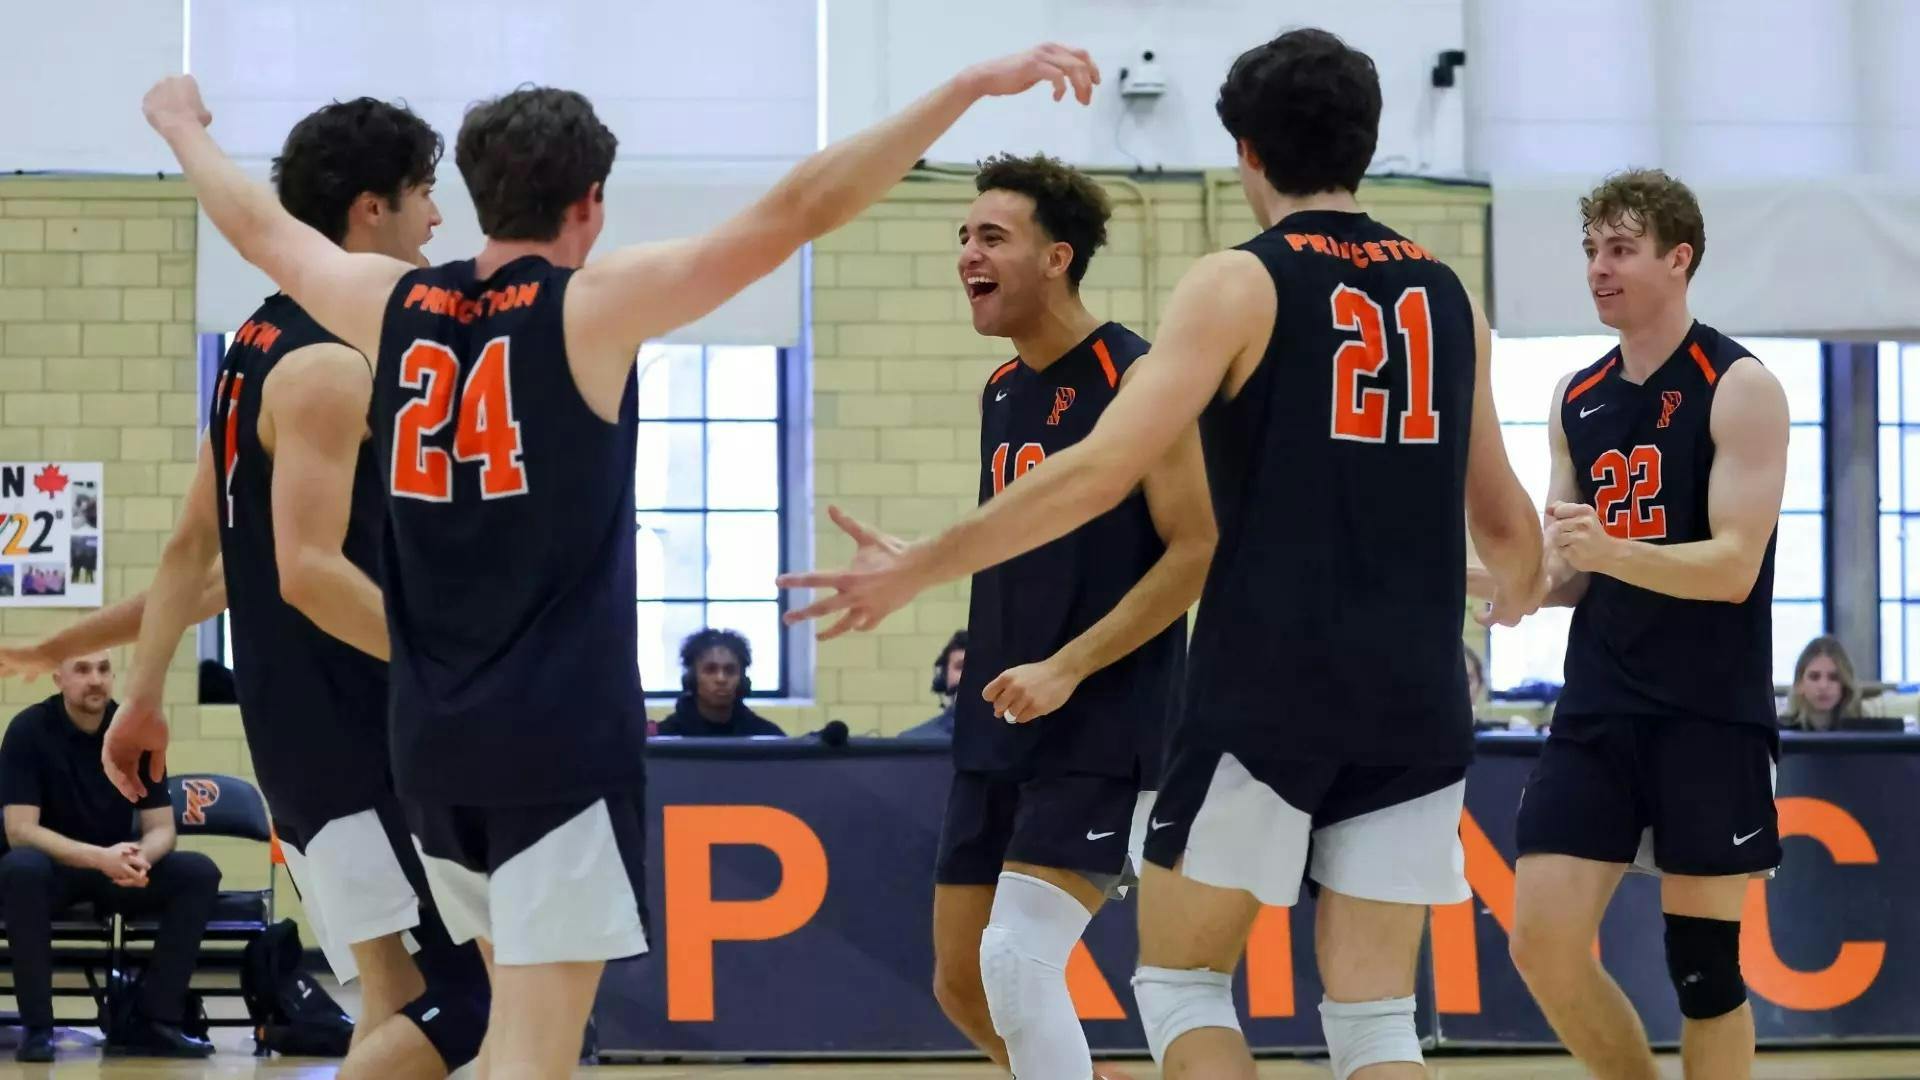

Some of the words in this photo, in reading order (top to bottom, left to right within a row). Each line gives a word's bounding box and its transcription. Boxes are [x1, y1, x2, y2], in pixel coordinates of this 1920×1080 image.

[391, 335, 529, 503] 24
[1330, 282, 1440, 444] 21
[1591, 444, 1667, 540] 22
[181, 778, 220, 826] P
[662, 796, 1887, 1022] PINC
